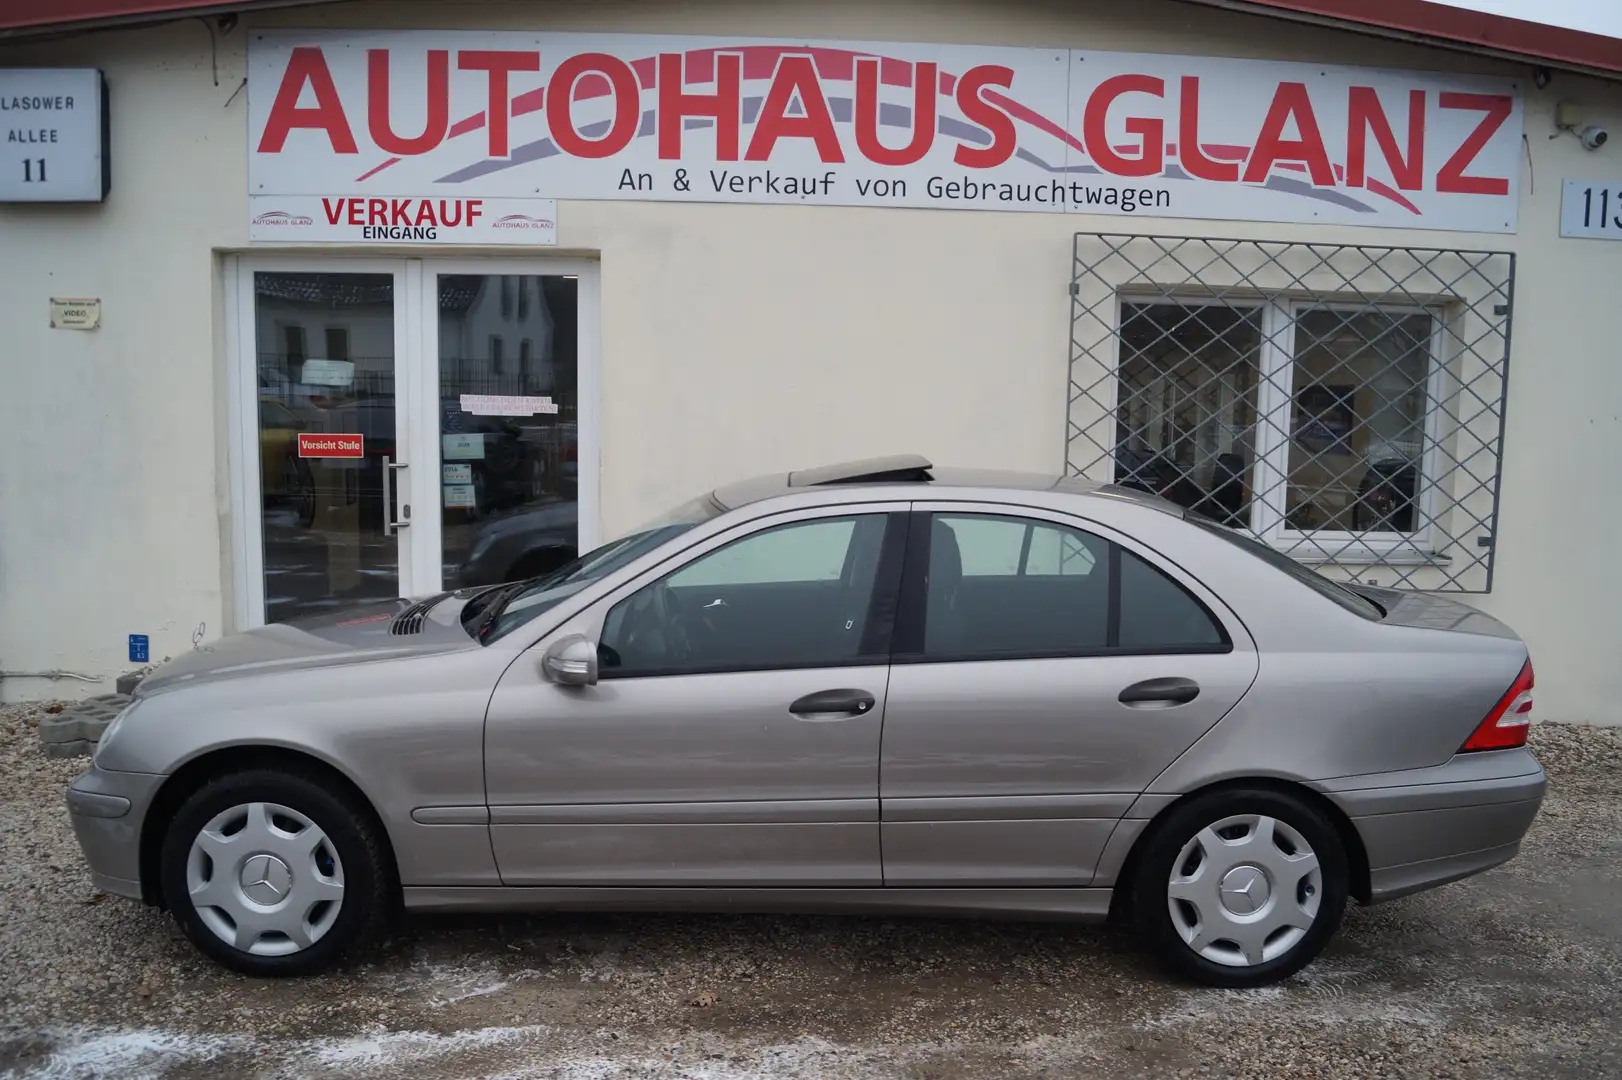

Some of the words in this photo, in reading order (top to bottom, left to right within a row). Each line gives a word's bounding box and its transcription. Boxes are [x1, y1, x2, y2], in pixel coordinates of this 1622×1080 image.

[257, 45, 1016, 169] AUTOHAUS
[1083, 73, 1514, 196] GLANZ
[8, 129, 59, 143] ALLEE
[21, 157, 48, 183] 11
[618, 168, 653, 191] An
[673, 168, 691, 192] &
[709, 169, 836, 196] Verkauf
[855, 178, 906, 198] von
[926, 175, 1171, 212] Gebrauchtwagen
[321, 197, 483, 228] VERKAUF
[252, 218, 289, 226] AUTOHAUS
[492, 221, 530, 229] AUTOHAUS
[363, 225, 437, 240] EINGANG
[301, 440, 336, 450] Vorsicht
[338, 440, 360, 450] Stufe
